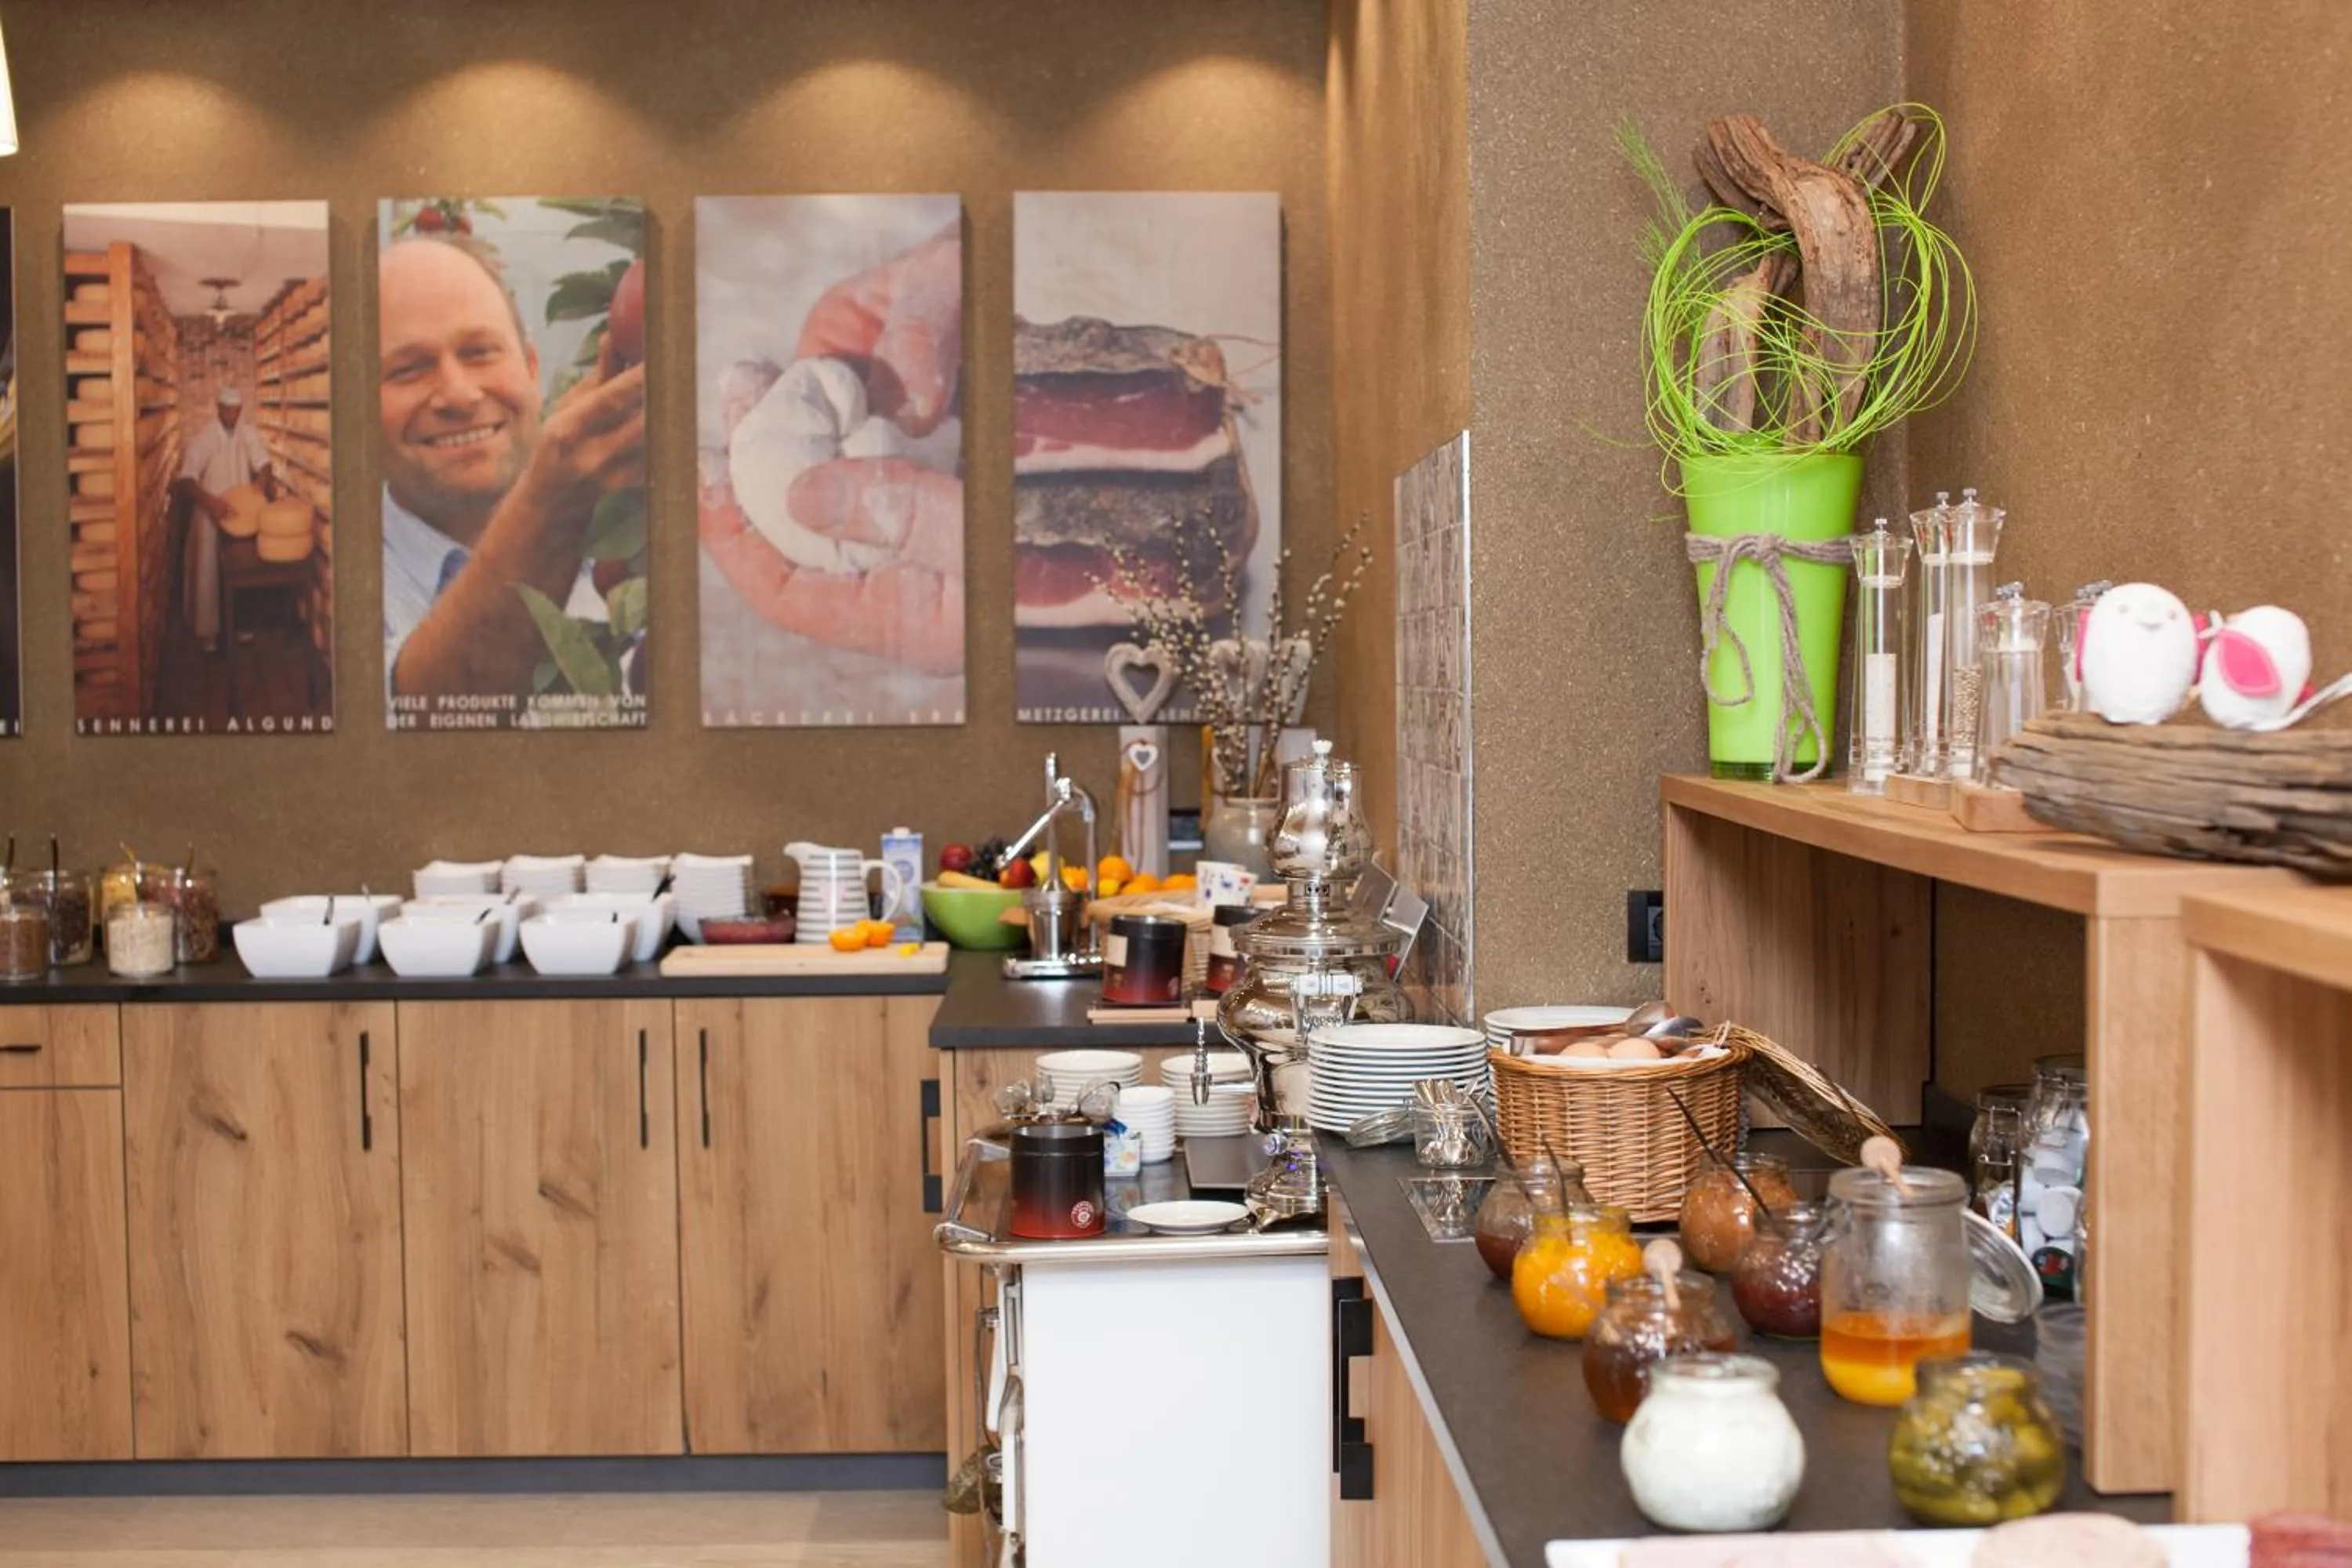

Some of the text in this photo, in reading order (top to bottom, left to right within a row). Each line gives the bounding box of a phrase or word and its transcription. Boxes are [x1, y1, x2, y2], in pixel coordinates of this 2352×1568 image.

[389, 694, 427, 710] VIELE
[438, 694, 517, 710] PRODUKTE
[607, 693, 647, 710] VON
[430, 711, 497, 728] EIGENEN
[1018, 706, 1120, 722] METZGEREI
[77, 714, 332, 735] SENNEREI ALGUND
